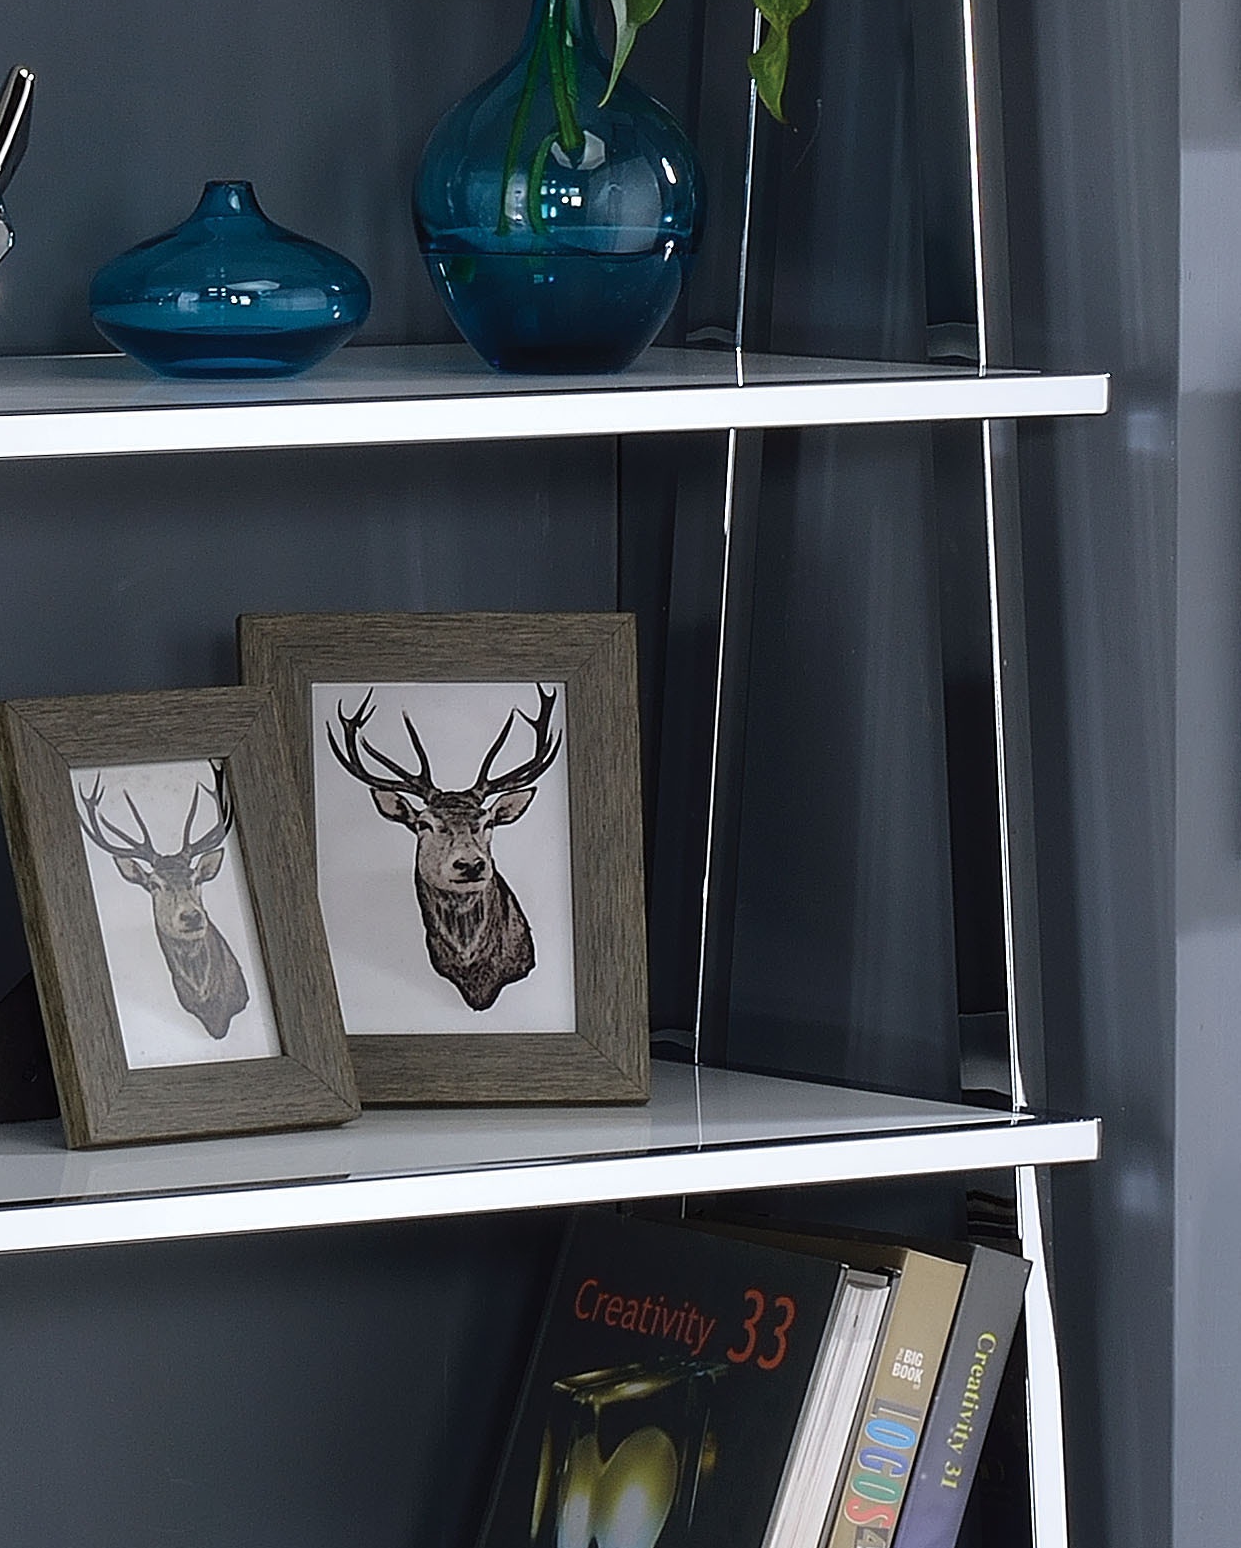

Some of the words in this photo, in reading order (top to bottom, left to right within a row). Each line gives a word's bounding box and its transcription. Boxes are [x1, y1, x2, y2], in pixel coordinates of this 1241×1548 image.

[574, 1279, 718, 1357] Creativity
[726, 1287, 796, 1371] 33
[891, 1362, 924, 1383] BOOK
[903, 1349, 924, 1368] BIG
[947, 1331, 998, 1456] Creativity
[939, 1460, 963, 1489] 31
